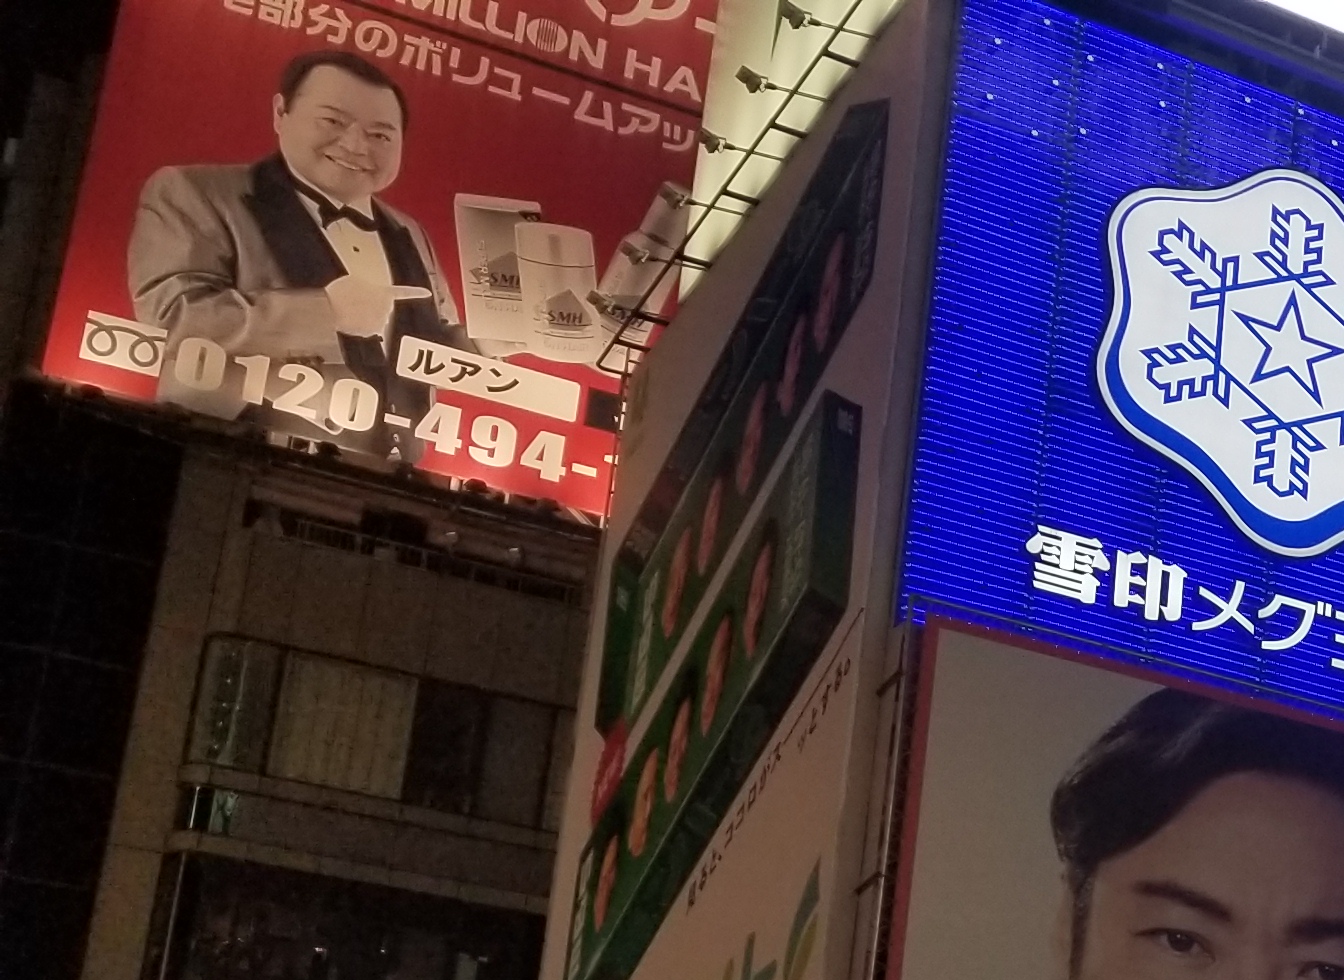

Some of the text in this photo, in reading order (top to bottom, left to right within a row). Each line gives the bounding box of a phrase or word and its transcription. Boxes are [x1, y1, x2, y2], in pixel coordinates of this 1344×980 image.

[549, 309, 583, 324] SMH
[407, 348, 520, 393] ルアン
[174, 336, 618, 484] 0120-494-
